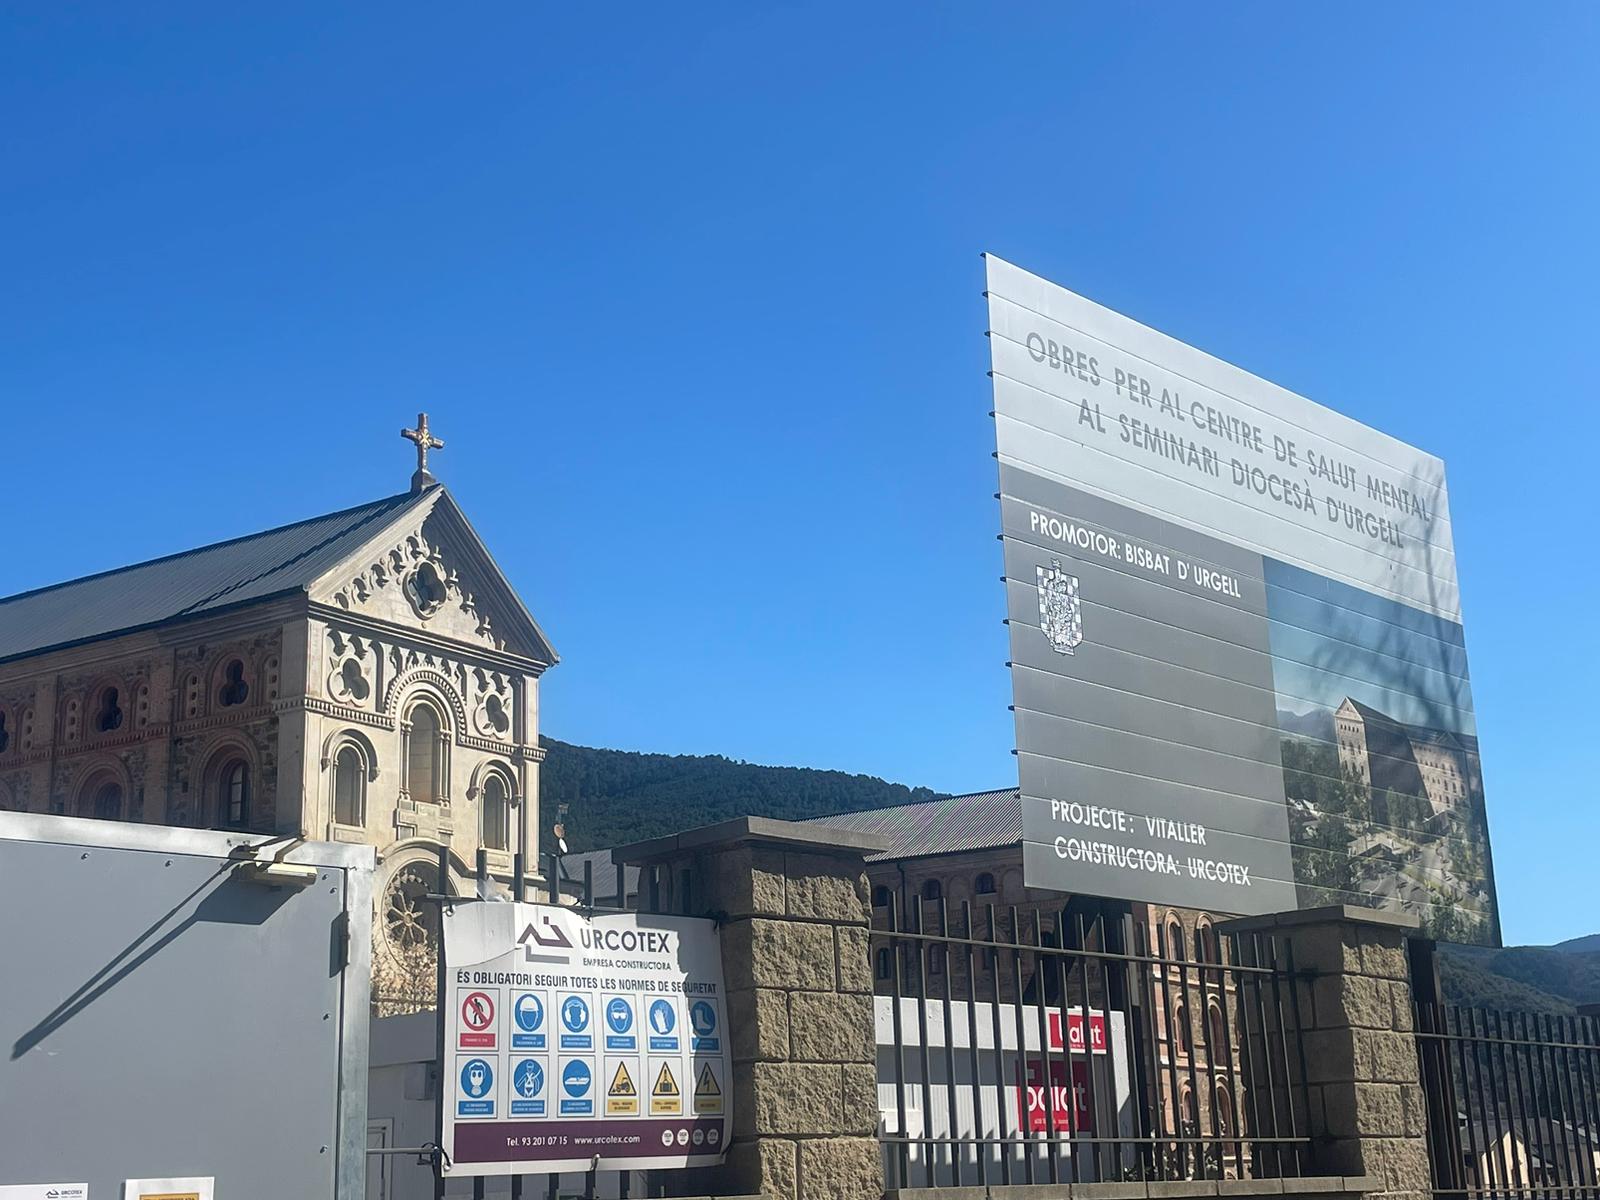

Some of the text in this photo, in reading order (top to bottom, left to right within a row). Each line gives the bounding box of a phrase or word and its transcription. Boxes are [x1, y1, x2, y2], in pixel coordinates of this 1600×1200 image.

[1026, 332, 1430, 522] OBRES PER AL CENTRE DE SALUT MENTAL
[1078, 398, 1404, 549] AL SEMINARI DIOCESÀ D'URGELL
[1030, 511, 1121, 560] PROMOTOR:
[1125, 542, 1170, 575] BISBAT
[1145, 816, 1206, 845] VITALLER
[1054, 836, 1251, 886] CONSTRUCTORA: URCOTEX
[580, 928, 670, 953] URCOTEX
[583, 957, 671, 971] EMPRESA CONSTRUCTORA
[457, 969, 717, 994] ÉS OBLIGATORI SEGUIR TOTES LES NORMES DE SEGURETAT
[506, 1135, 640, 1146] Tel. 93 201 07 15 www.urcotex.com
